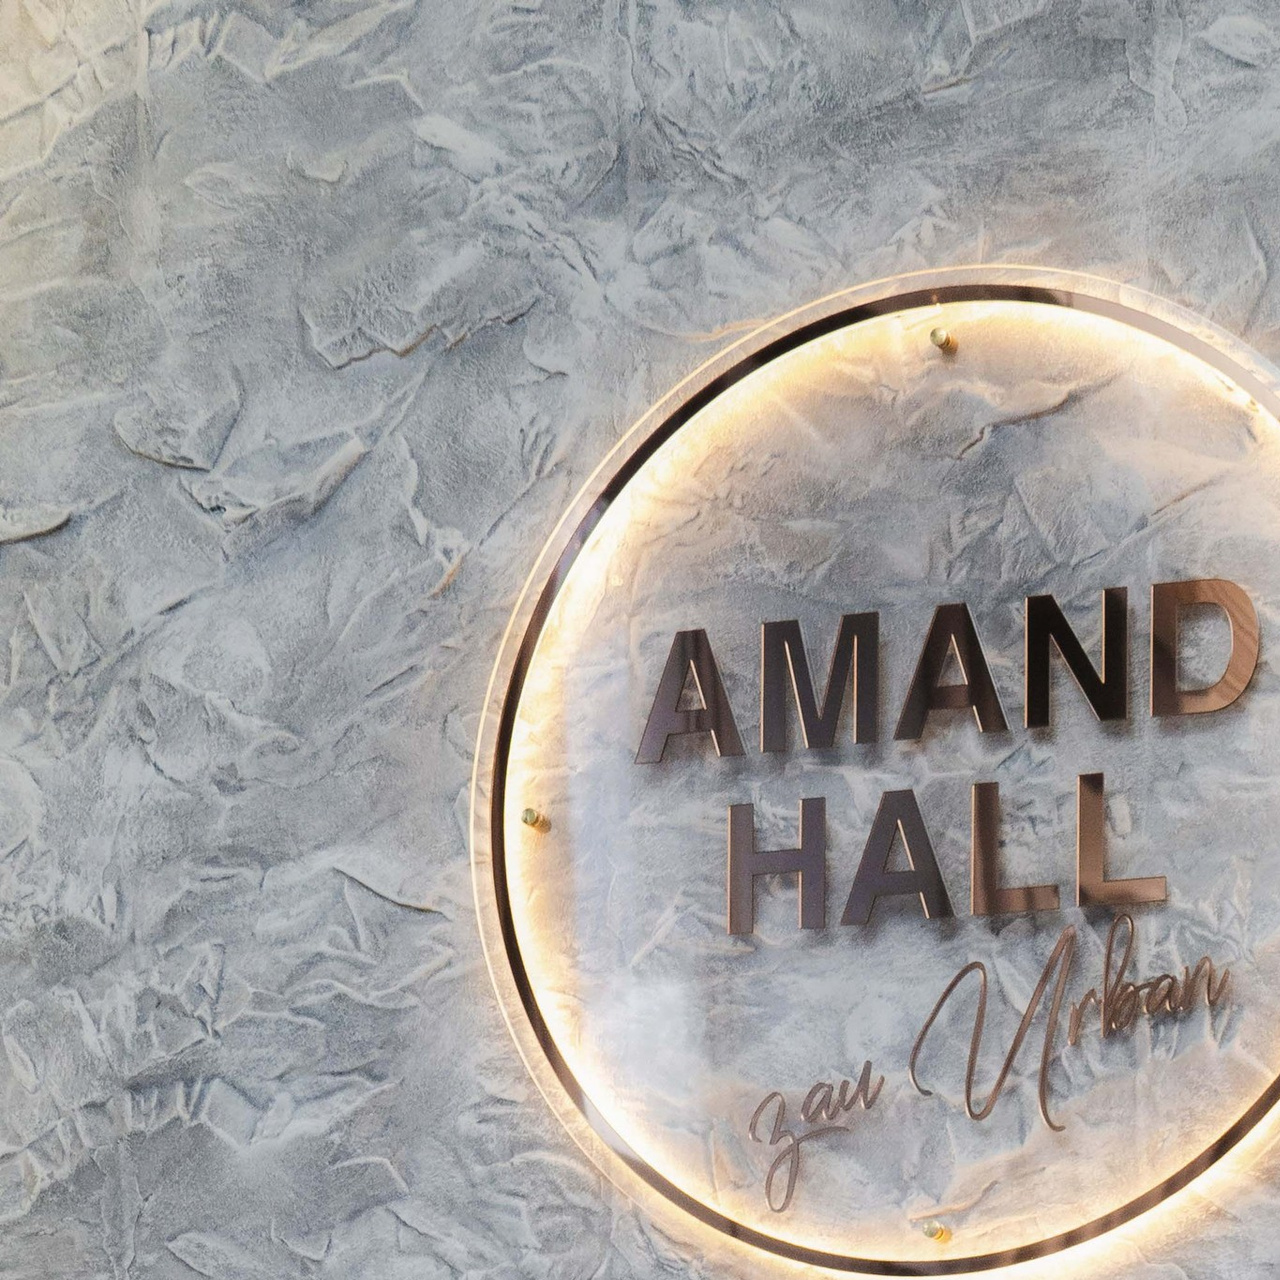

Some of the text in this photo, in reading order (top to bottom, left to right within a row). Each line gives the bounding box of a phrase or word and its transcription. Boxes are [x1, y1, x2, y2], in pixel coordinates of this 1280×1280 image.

[634, 578, 1260, 765] AMAND
[726, 772, 1167, 936] HALL
[909, 913, 1231, 1132] Urban
